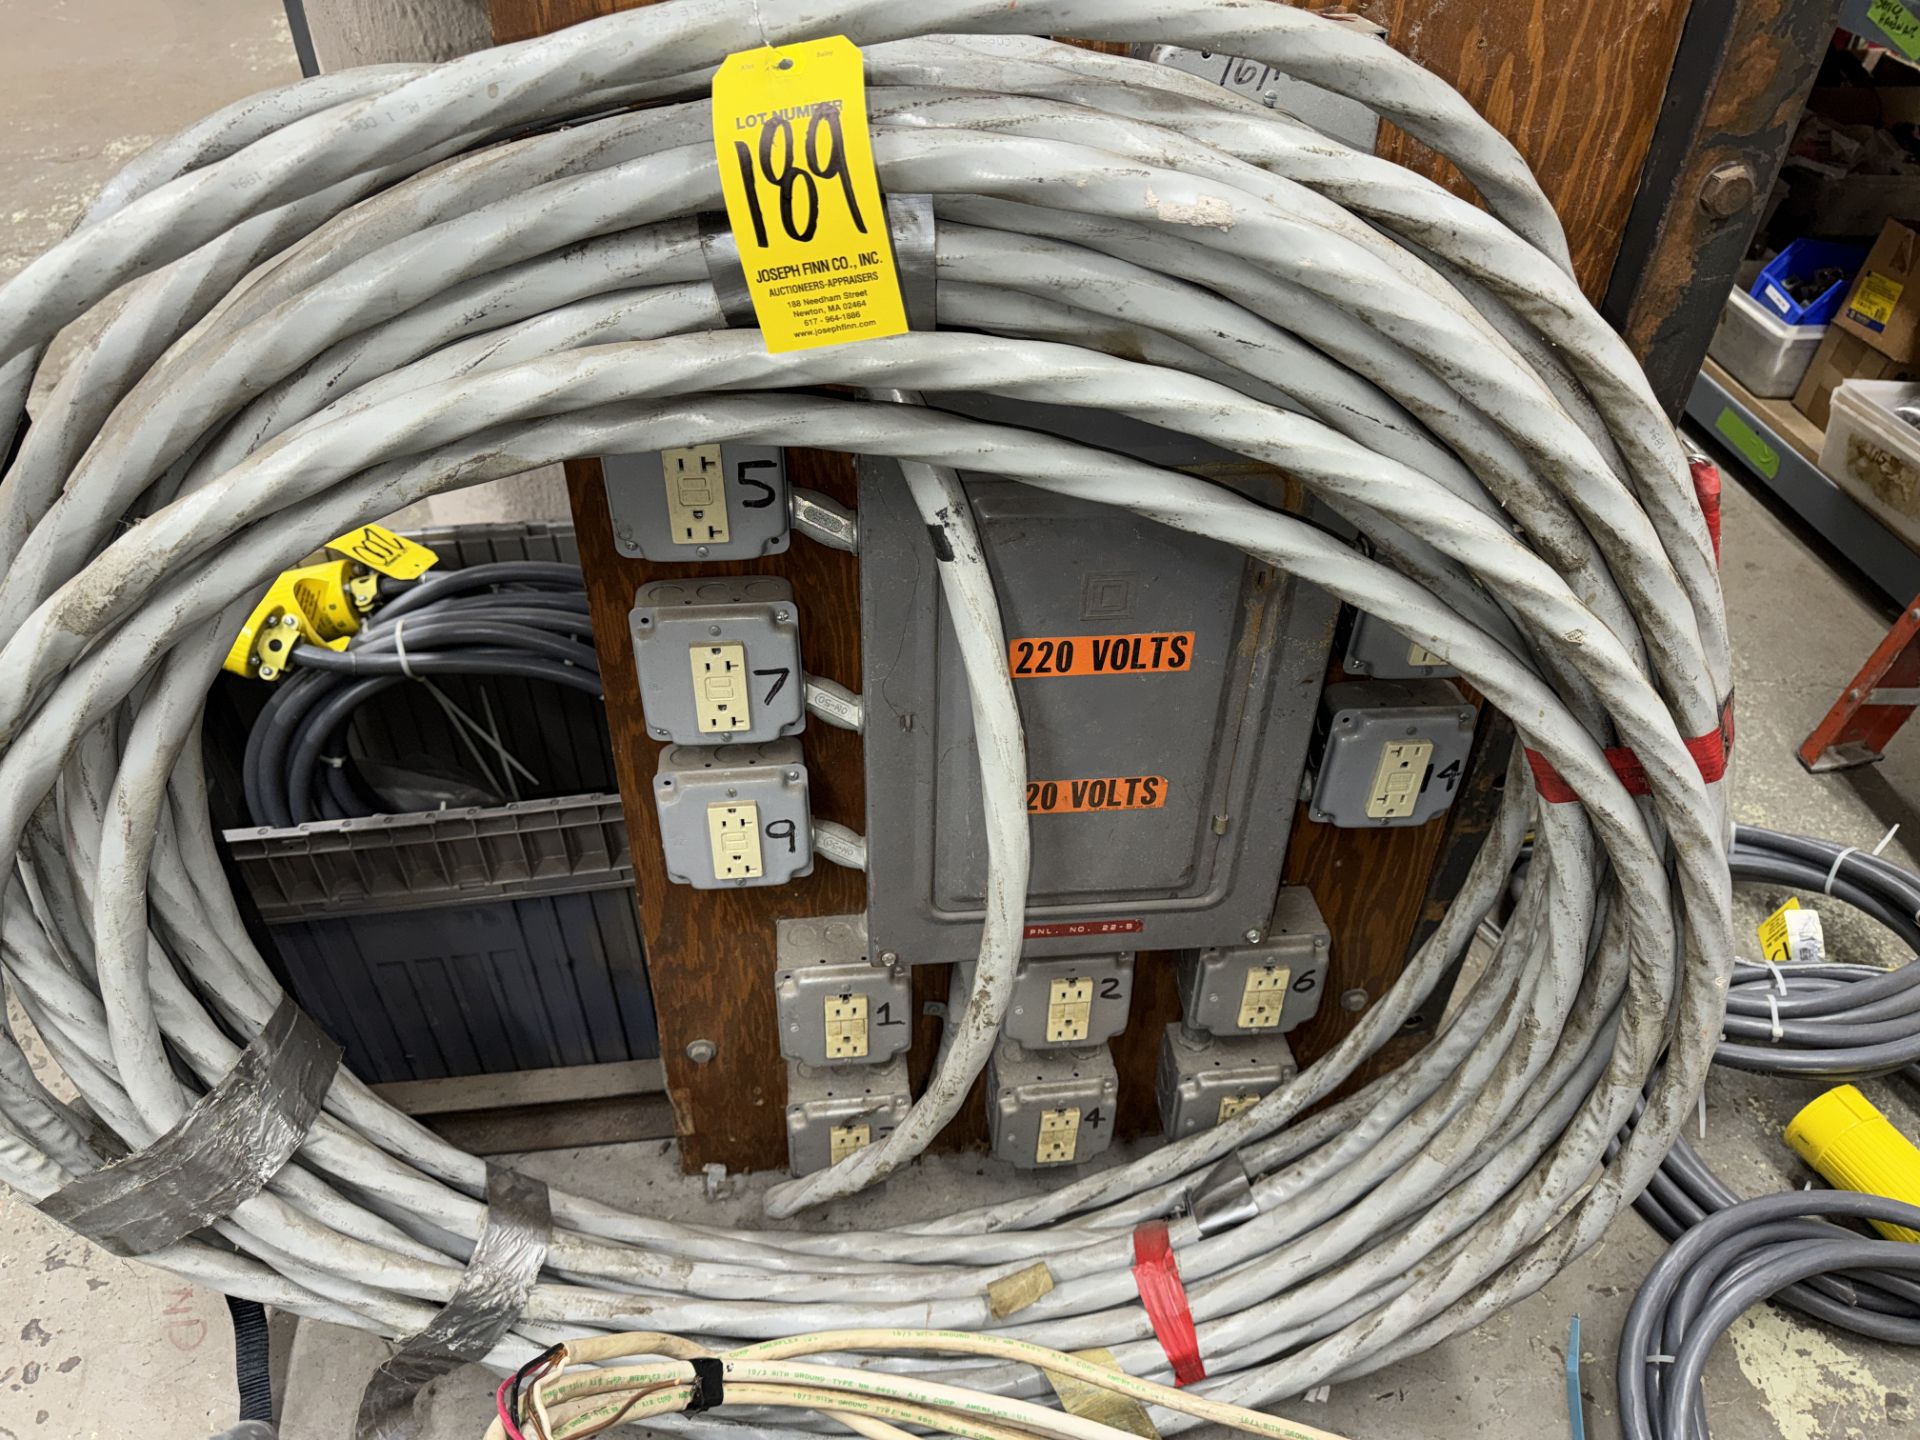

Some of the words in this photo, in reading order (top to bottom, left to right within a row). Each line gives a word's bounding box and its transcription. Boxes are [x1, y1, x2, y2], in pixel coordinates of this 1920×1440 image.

[735, 112, 768, 130] LOT
[734, 104, 868, 248] 189
[756, 264, 801, 283] JOSEPH
[802, 259, 830, 276] FINN
[831, 255, 858, 271] CO.,
[858, 251, 883, 266] INC.
[769, 271, 879, 297] AUCTIONEERS-APPRAISERS
[787, 300, 801, 308] 188
[803, 294, 842, 306] Needham
[843, 289, 868, 300] Street
[793, 307, 827, 318] Newton,
[828, 304, 842, 312] MA
[842, 300, 867, 311] 02464
[793, 319, 877, 338] www.josephfinn.com
[803, 318, 818, 327] 617
[825, 311, 861, 323] 964-1886
[738, 460, 777, 508] 5
[1015, 640, 1074, 674] 220
[1092, 635, 1188, 671] VOLTS
[753, 667, 790, 706] 7
[1420, 759, 1462, 794] 14
[1026, 782, 1058, 811] 20
[1071, 776, 1159, 809] VOLTS
[765, 819, 796, 853] 9
[1029, 928, 1059, 936] PNL.
[1069, 925, 1091, 934] NO.
[1100, 977, 1122, 1000] 2
[1292, 969, 1317, 993] 6
[876, 1002, 906, 1027] 1
[1083, 1107, 1106, 1130] 4
[831, 1377, 853, 1387] TYPE
